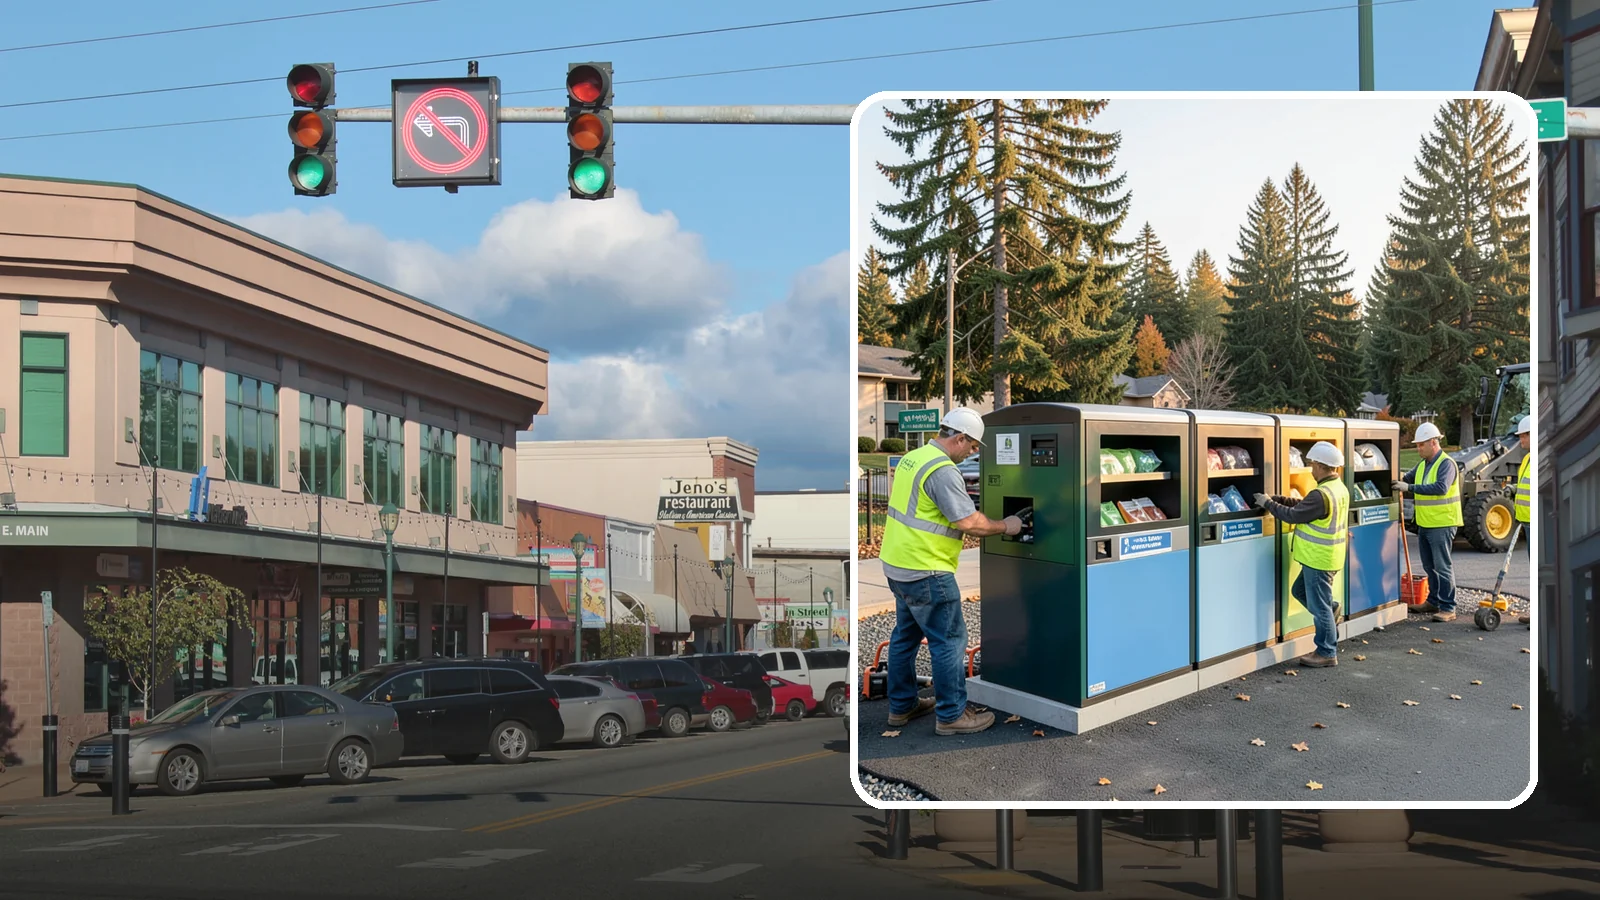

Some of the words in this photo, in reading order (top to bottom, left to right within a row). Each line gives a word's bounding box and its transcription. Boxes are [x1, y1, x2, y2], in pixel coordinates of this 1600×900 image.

[670, 480, 727, 494] Jeno's
[665, 497, 731, 509] restaurant
[658, 510, 681, 519] Italian
[686, 510, 715, 519] American
[715, 510, 737, 519] Cuisine
[2, 525, 13, 536] E.
[16, 525, 49, 536] MAIN
[797, 608, 828, 616] Street
